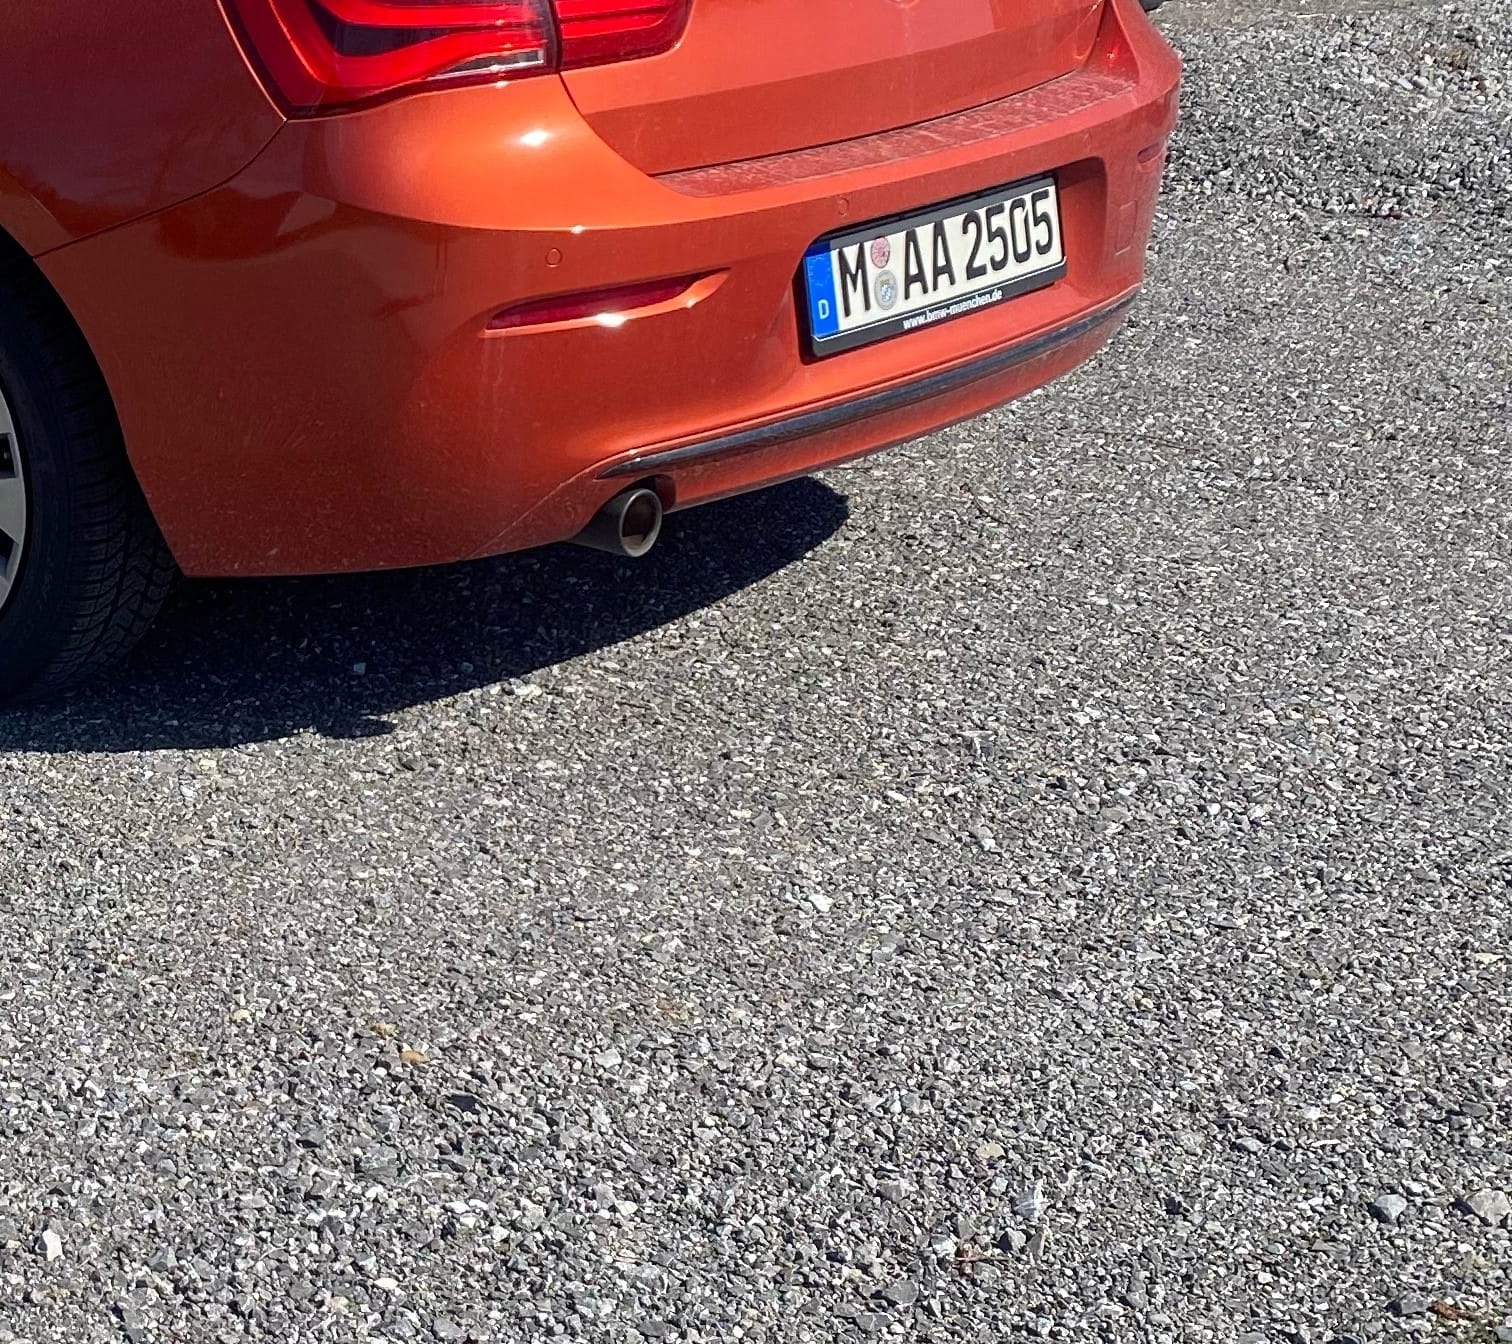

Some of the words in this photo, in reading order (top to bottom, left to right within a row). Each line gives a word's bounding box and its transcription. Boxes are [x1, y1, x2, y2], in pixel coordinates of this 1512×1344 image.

[837, 242, 871, 318] M
[904, 220, 956, 300] AA
[962, 189, 1054, 281] 2505
[818, 299, 830, 320] D
[903, 288, 1003, 330] www.bmw-muenchen.de
